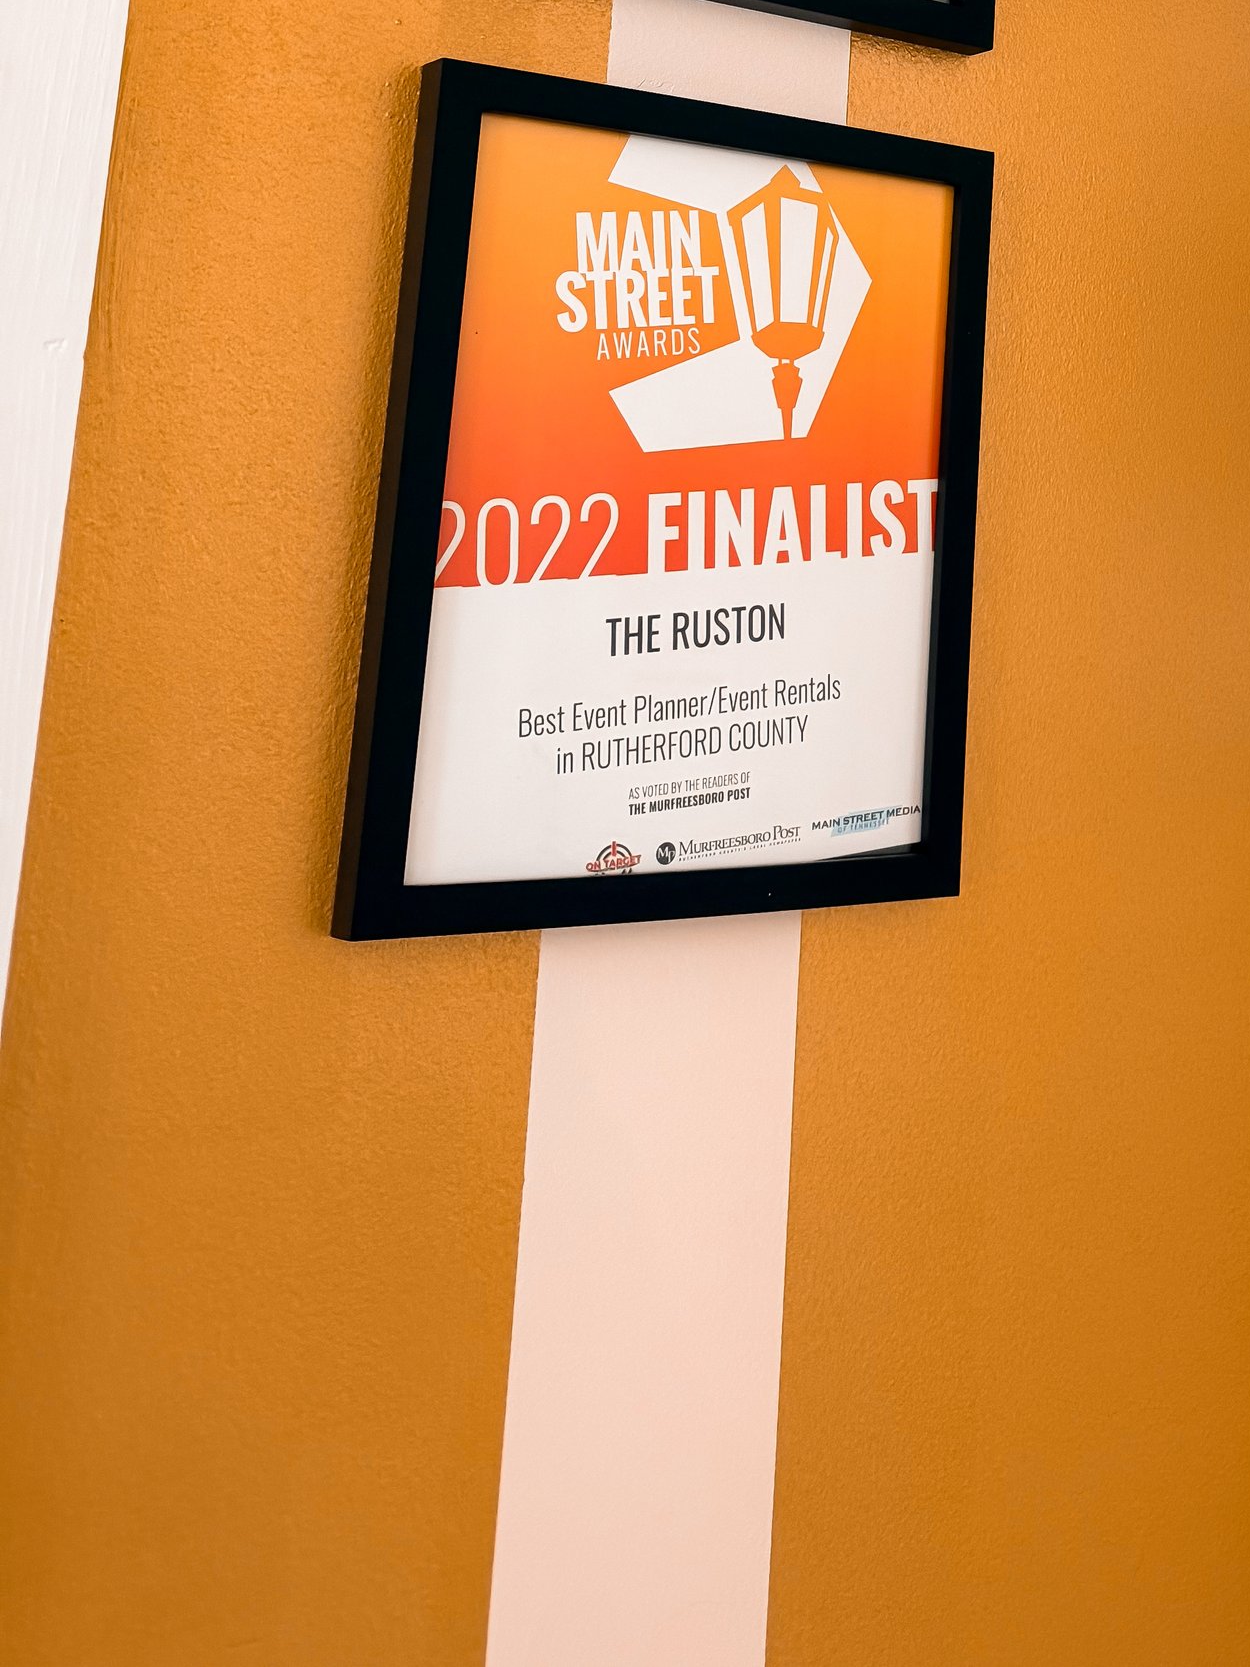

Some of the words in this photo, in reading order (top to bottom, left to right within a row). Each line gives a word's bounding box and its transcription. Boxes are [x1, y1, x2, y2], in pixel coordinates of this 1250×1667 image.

[576, 210, 702, 274] MAIN
[555, 265, 720, 333] STREET
[597, 327, 702, 361] AWARDS
[435, 492, 620, 588] 2022
[647, 478, 939, 573] FINALIST
[605, 614, 661, 657] THE
[672, 602, 786, 651] RUSTON
[518, 706, 566, 738] Best
[572, 699, 627, 732] Event
[634, 684, 769, 725] Planner/Event
[774, 674, 842, 707] Rentals
[556, 747, 574, 775] in
[582, 725, 722, 772] RUTHERFORD
[728, 715, 809, 751] COUNTY
[628, 787, 640, 800] AS
[642, 783, 669, 798] VOTED
[671, 780, 683, 794] BY
[684, 778, 700, 792] THE
[702, 773, 738, 790] READERS
[740, 771, 751, 784] OF
[628, 802, 647, 816] THE
[649, 790, 725, 813] MURFREESBORO
[727, 787, 751, 801] POST
[811, 817, 841, 831] MAIN
[842, 811, 885, 826] STREET
[886, 804, 921, 819] MEDIA
[678, 830, 771, 856] MURFREESBORO
[773, 825, 801, 841] POST
[585, 860, 601, 872] ON
[602, 854, 642, 870] TARGET
